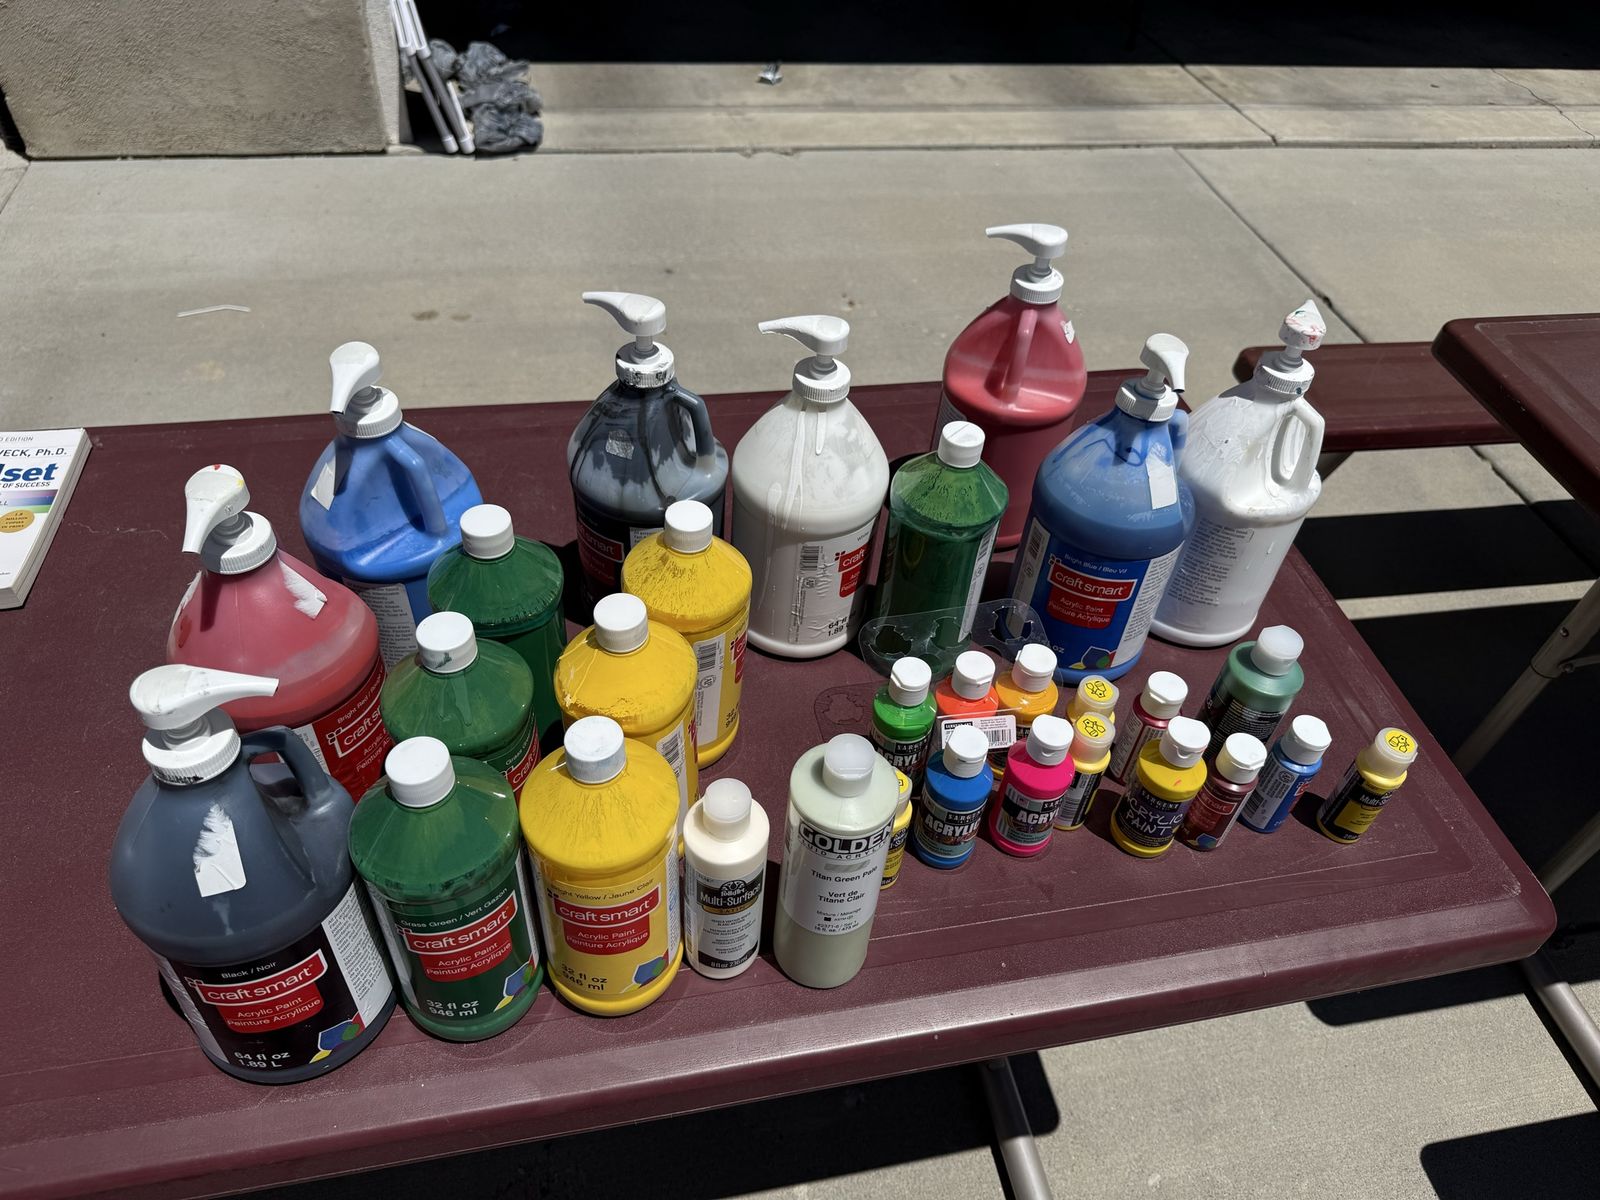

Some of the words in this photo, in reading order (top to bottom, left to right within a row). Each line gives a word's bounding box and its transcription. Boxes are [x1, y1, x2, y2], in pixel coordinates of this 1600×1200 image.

[35, 447, 67, 456] Ph.D.
[1083, 561, 1098, 570] Blue
[1055, 571, 1083, 590] craft
[1084, 583, 1123, 596] smart
[1060, 597, 1083, 610] Acrylic
[1086, 604, 1104, 614] Paint
[828, 620, 839, 629] 64
[1077, 612, 1111, 624] Acrylique
[343, 718, 373, 745] craft
[1126, 810, 1172, 836] PAINT
[800, 822, 893, 854] GOLDEN
[811, 869, 832, 882] Titan
[834, 874, 860, 883] Green
[862, 866, 878, 878] Pale
[574, 890, 602, 901] Yellow
[608, 888, 635, 900] Jaune
[700, 883, 761, 906] Multi-Surface
[818, 895, 844, 904] Titane
[846, 893, 865, 902] Clair
[428, 917, 458, 928] Green
[461, 906, 482, 919] Vert
[559, 905, 598, 922] craft
[599, 899, 650, 922] smart
[413, 936, 456, 950] craft
[457, 909, 508, 943] smart
[578, 931, 609, 941] Acrylic
[612, 928, 636, 939] Paint
[566, 936, 604, 949] Peinture
[606, 931, 649, 949] Acrylique
[426, 966, 467, 976] Peinture
[470, 942, 511, 969] Acrylique
[438, 955, 472, 968] Acrylic
[474, 942, 499, 958] Paint
[221, 968, 249, 980] Black
[256, 961, 277, 974] Noir
[562, 963, 575, 975] 32
[578, 969, 587, 980] fl
[207, 988, 251, 1002] craft
[252, 966, 311, 996] smart
[562, 970, 584, 987] 946
[587, 981, 605, 991] ml
[227, 1018, 270, 1028] Peinture
[273, 999, 321, 1023] Acrylique
[237, 1007, 274, 1018] Acrylic
[275, 996, 303, 1011] Paint
[426, 999, 442, 1009] 32
[447, 1000, 457, 1010] fl
[463, 999, 480, 1008] oz
[428, 1007, 454, 1017] 946
[459, 1007, 478, 1016] ml
[234, 1051, 253, 1061] 64
[258, 1052, 268, 1061] fl
[272, 1051, 291, 1059] oz
[272, 1059, 283, 1067] L
